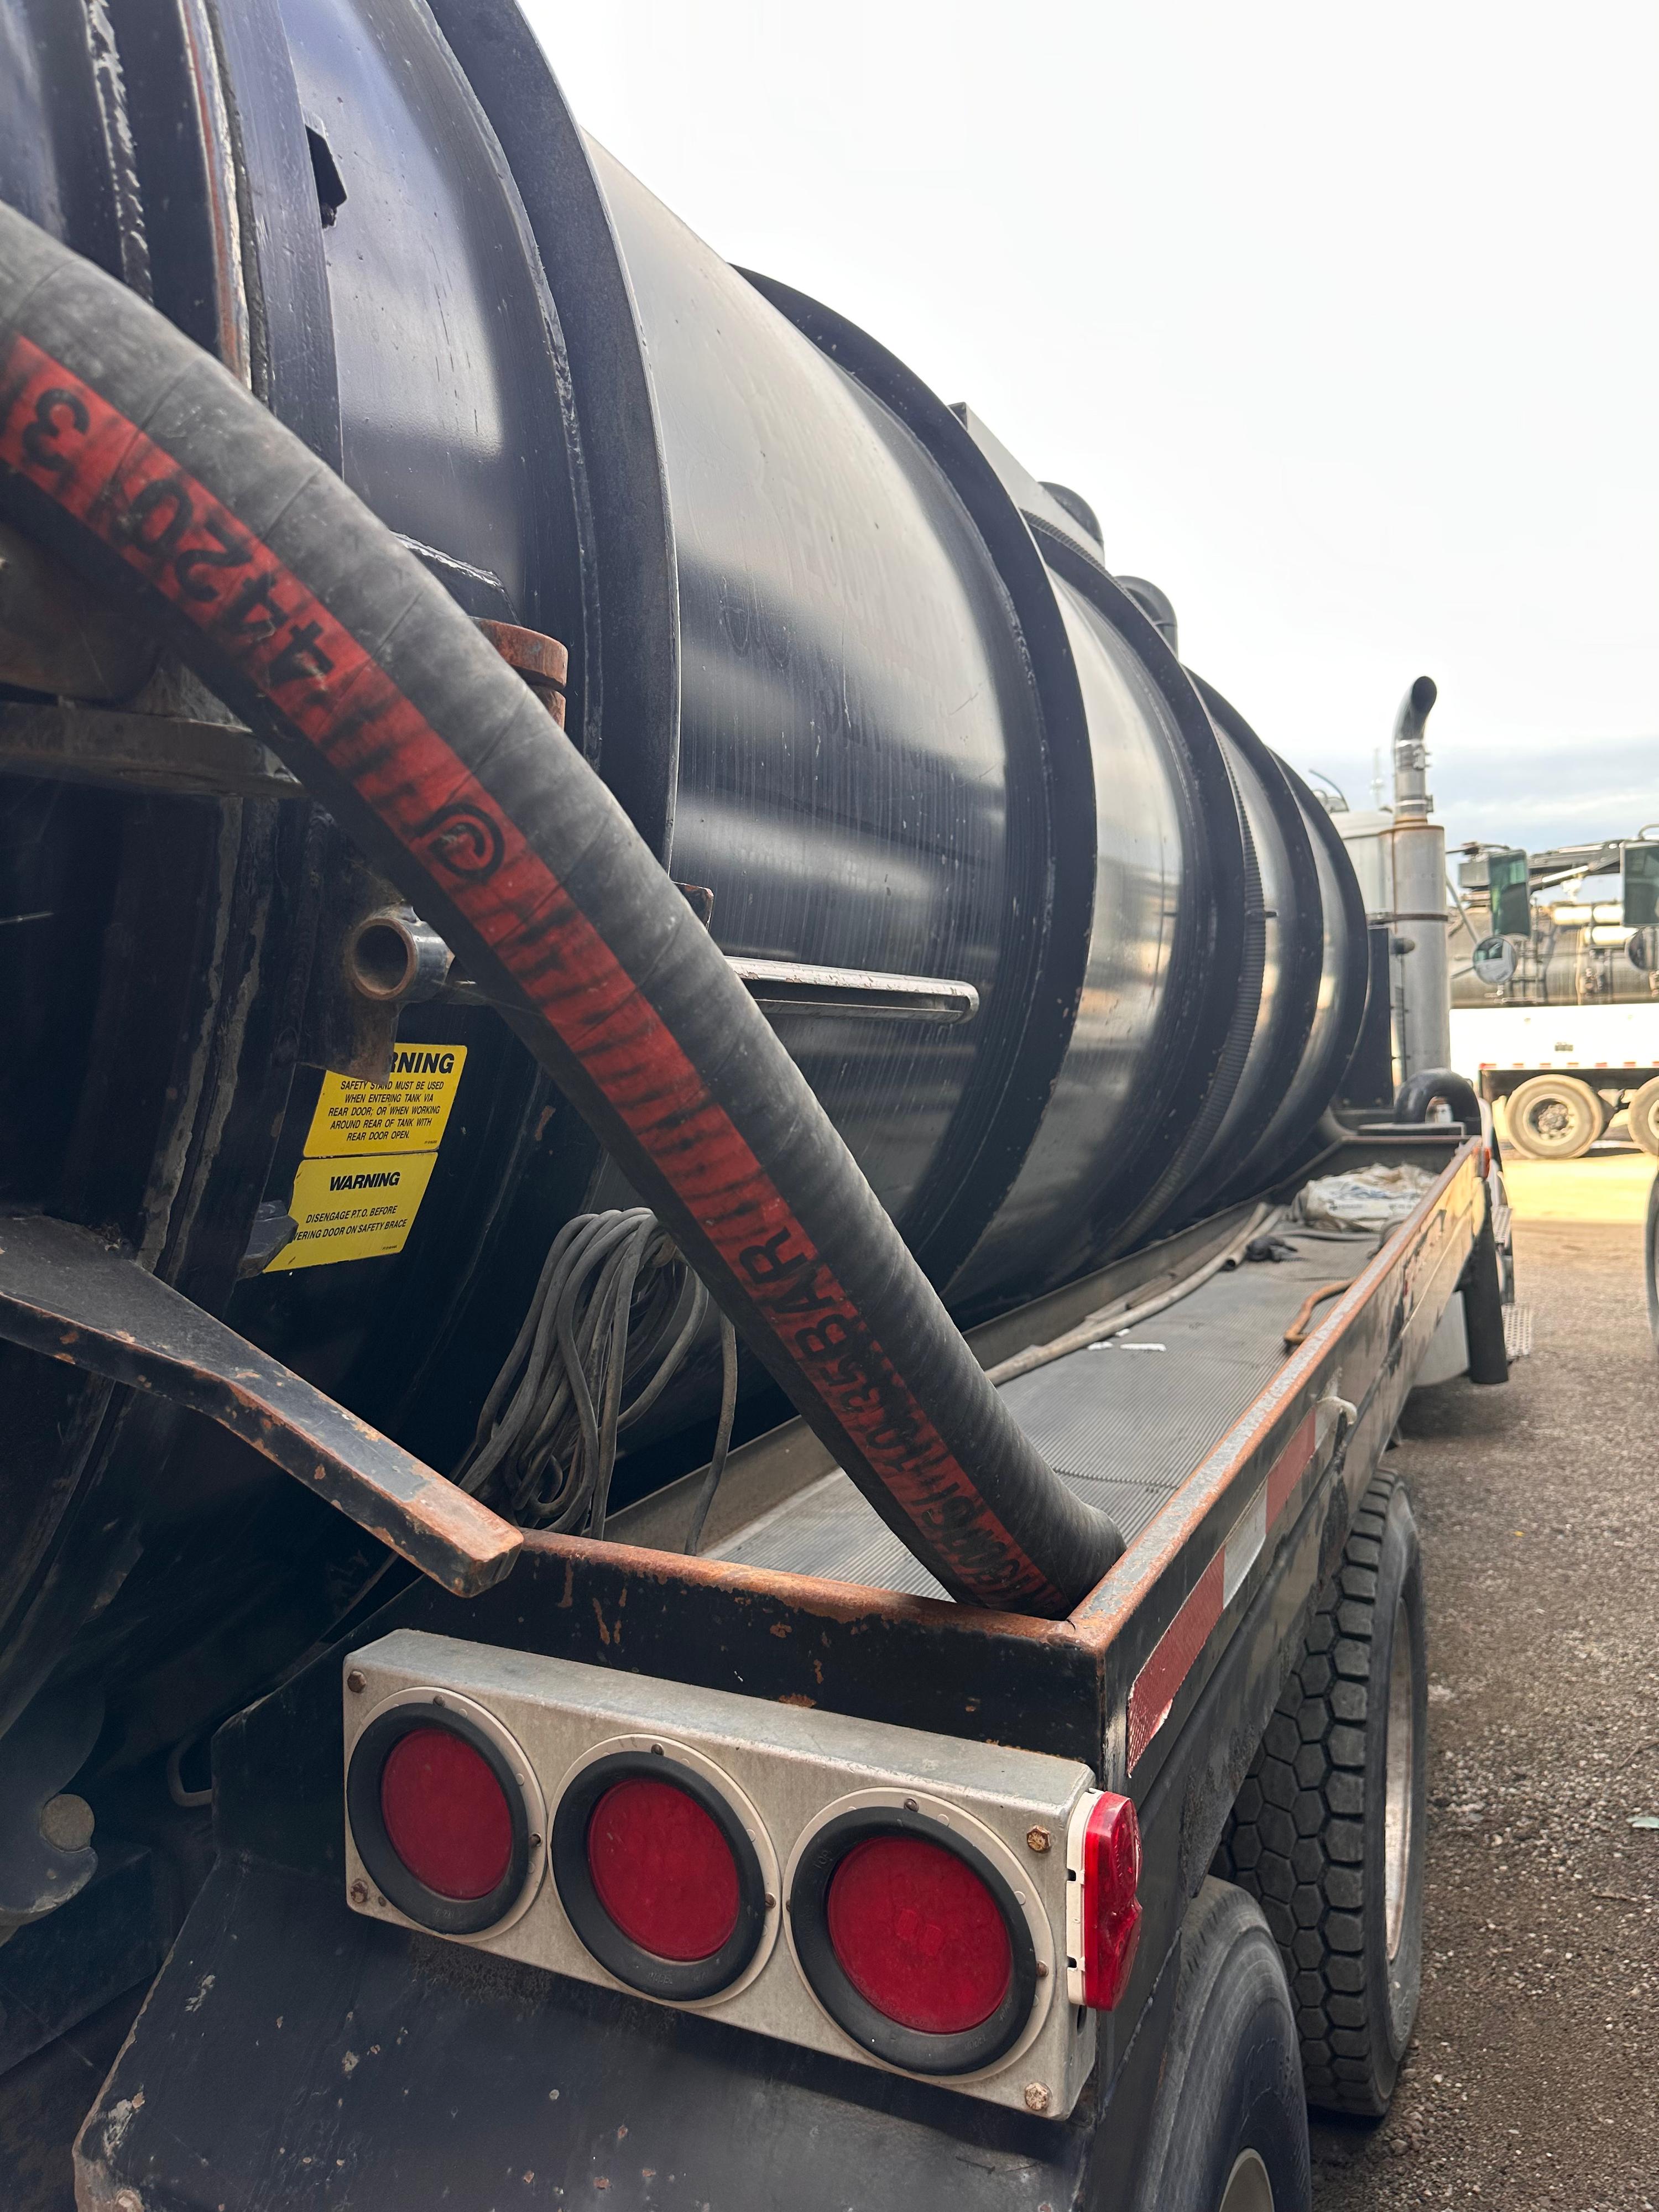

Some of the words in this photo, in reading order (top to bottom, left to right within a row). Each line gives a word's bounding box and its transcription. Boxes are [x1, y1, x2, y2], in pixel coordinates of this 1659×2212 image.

[390, 1052, 455, 1074] NING
[340, 1081, 368, 1090] SAFETY
[395, 1081, 414, 1089] MUST
[416, 1081, 425, 1089] BE
[427, 1081, 444, 1089] USED
[345, 1094, 366, 1103] WHEN
[368, 1094, 401, 1103] ENTERING
[405, 1094, 421, 1102] TANK
[424, 1094, 434, 1102] VIA
[328, 1107, 348, 1117] REAR
[351, 1107, 374, 1117] DOOR;
[377, 1107, 387, 1115] OR
[389, 1107, 409, 1115] WHEN
[411, 1106, 441, 1114] WORKING
[330, 1120, 361, 1129] AROUND
[363, 1119, 383, 1128] REAR
[384, 1119, 395, 1128] OF
[398, 1119, 413, 1127] TANK
[416, 1118, 432, 1126] WITH
[347, 1132, 366, 1141] REAR
[368, 1131, 389, 1140] DOOR
[391, 1131, 410, 1139] OPEN.
[330, 1171, 401, 1191] WARNING
[306, 1210, 351, 1224] DISENGAGE
[369, 1205, 398, 1217] BEFORE
[322, 1227, 345, 1238] DOOR
[346, 1225, 357, 1235] ON
[357, 1222, 384, 1233] SAFETY
[384, 1218, 408, 1230] BRACE
